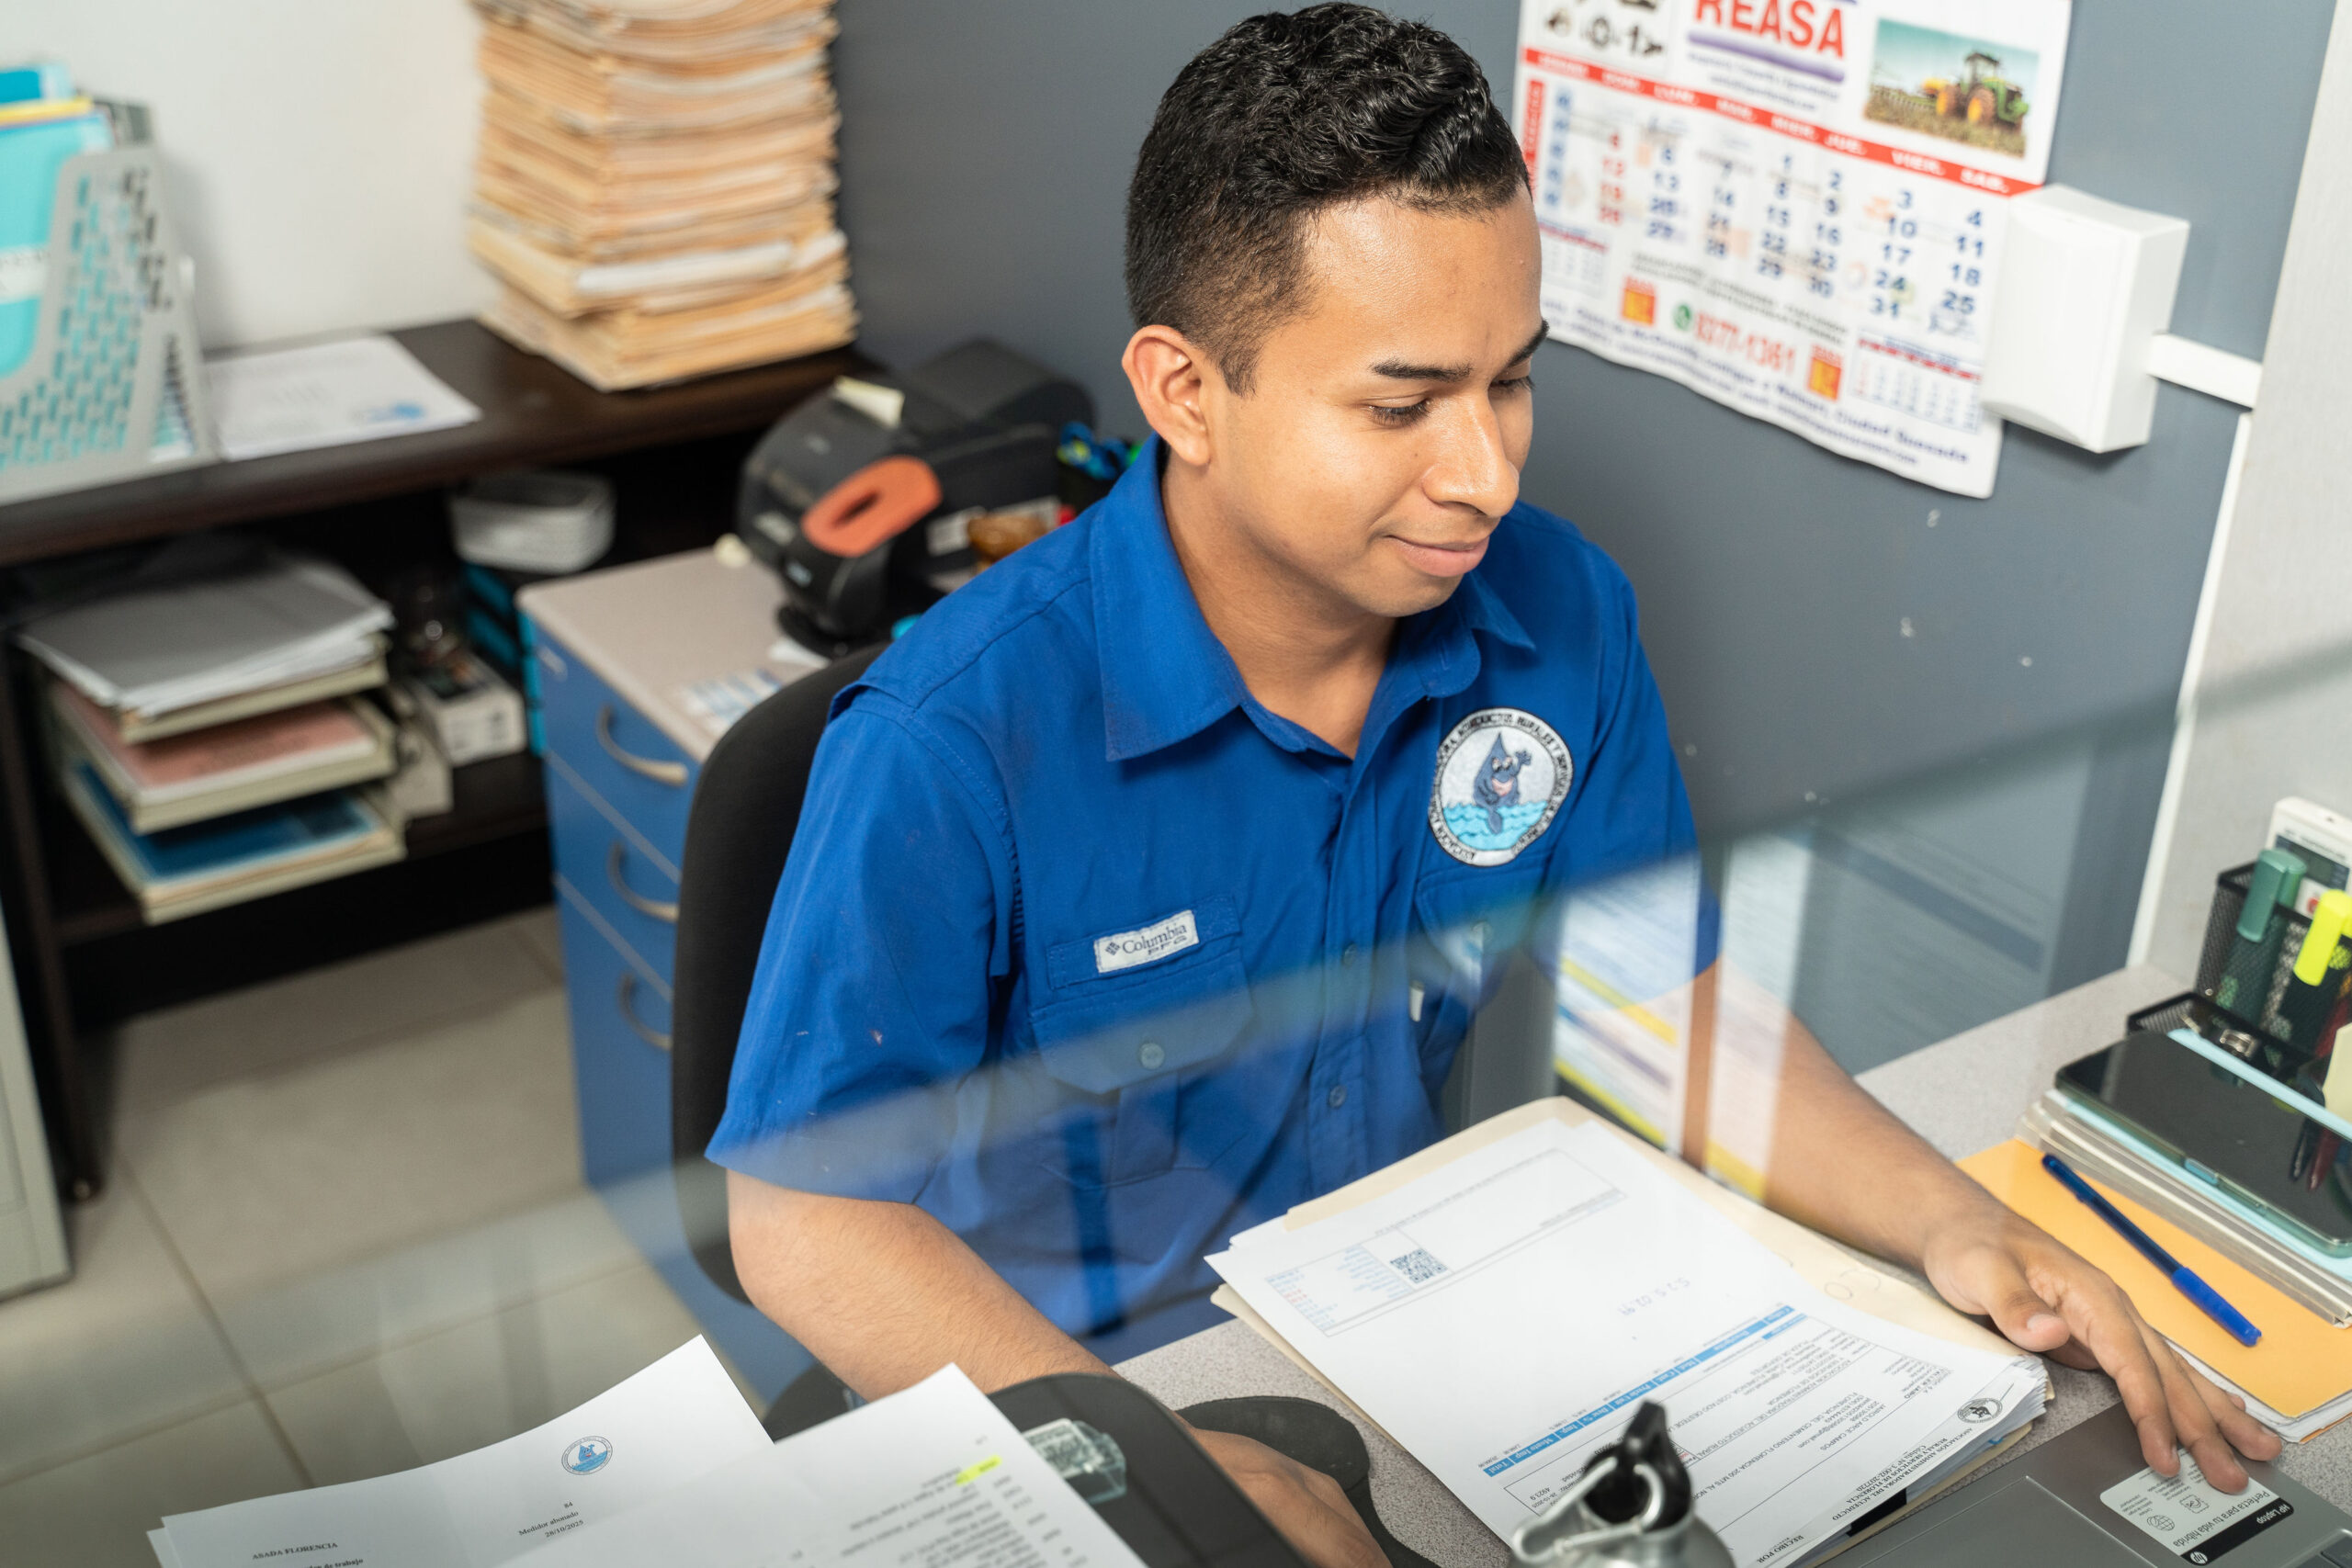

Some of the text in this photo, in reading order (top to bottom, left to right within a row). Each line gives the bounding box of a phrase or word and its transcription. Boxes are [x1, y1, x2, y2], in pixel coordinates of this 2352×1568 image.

[1891, 149, 1947, 175] VIER.
[1829, 171, 1842, 190] 2
[1897, 190, 1914, 209] 3
[1967, 209, 1982, 227] 4
[1777, 181, 1789, 199] 8
[1826, 197, 1839, 217] 9
[1888, 215, 1917, 239] 10
[1957, 235, 1984, 258] 11
[1768, 204, 1790, 228] 15
[1816, 222, 1841, 246] 16
[1883, 243, 1912, 265] 17
[1952, 264, 1981, 287] 18
[1761, 230, 1785, 254] 22
[1811, 248, 1836, 272] 23
[1875, 269, 1906, 292] 24
[1942, 290, 1975, 315] 25
[1759, 255, 1783, 279] 29
[1809, 274, 1834, 299] 30
[1871, 296, 1900, 319] 31
[1123, 924, 1187, 954] Columbia
[1772, 1423, 1812, 1448] CEMENTERIO
[1844, 1421, 1863, 1433] ARCE
[1818, 1433, 1847, 1450] CAMPOS
[1738, 1447, 1774, 1469] FLORENCIA
[1890, 1454, 1922, 1475] SERVICIOS
[1882, 1451, 1936, 1488] ADMINISTRADORA
[1529, 1486, 1551, 1500] 4923.9
[1845, 1482, 1882, 1504] FLORENCIA
[1870, 1488, 1883, 1496] DEL
[2236, 1490, 2269, 1510] Perfecta
[1831, 1496, 1871, 1520] ACUEDUCTO
[2220, 1506, 2239, 1518] para
[2255, 1504, 2290, 1524] HP Laptop
[518, 1511, 579, 1536] Medidor abonado
[544, 1519, 583, 1538] 28/10/2025
[2197, 1521, 2215, 1533] vida
[2211, 1516, 2223, 1524] tu
[253, 1542, 338, 1560] ASADA FLORENCIA
[1772, 1535, 1804, 1551] RECIBO
[1755, 1551, 1774, 1562] POR
